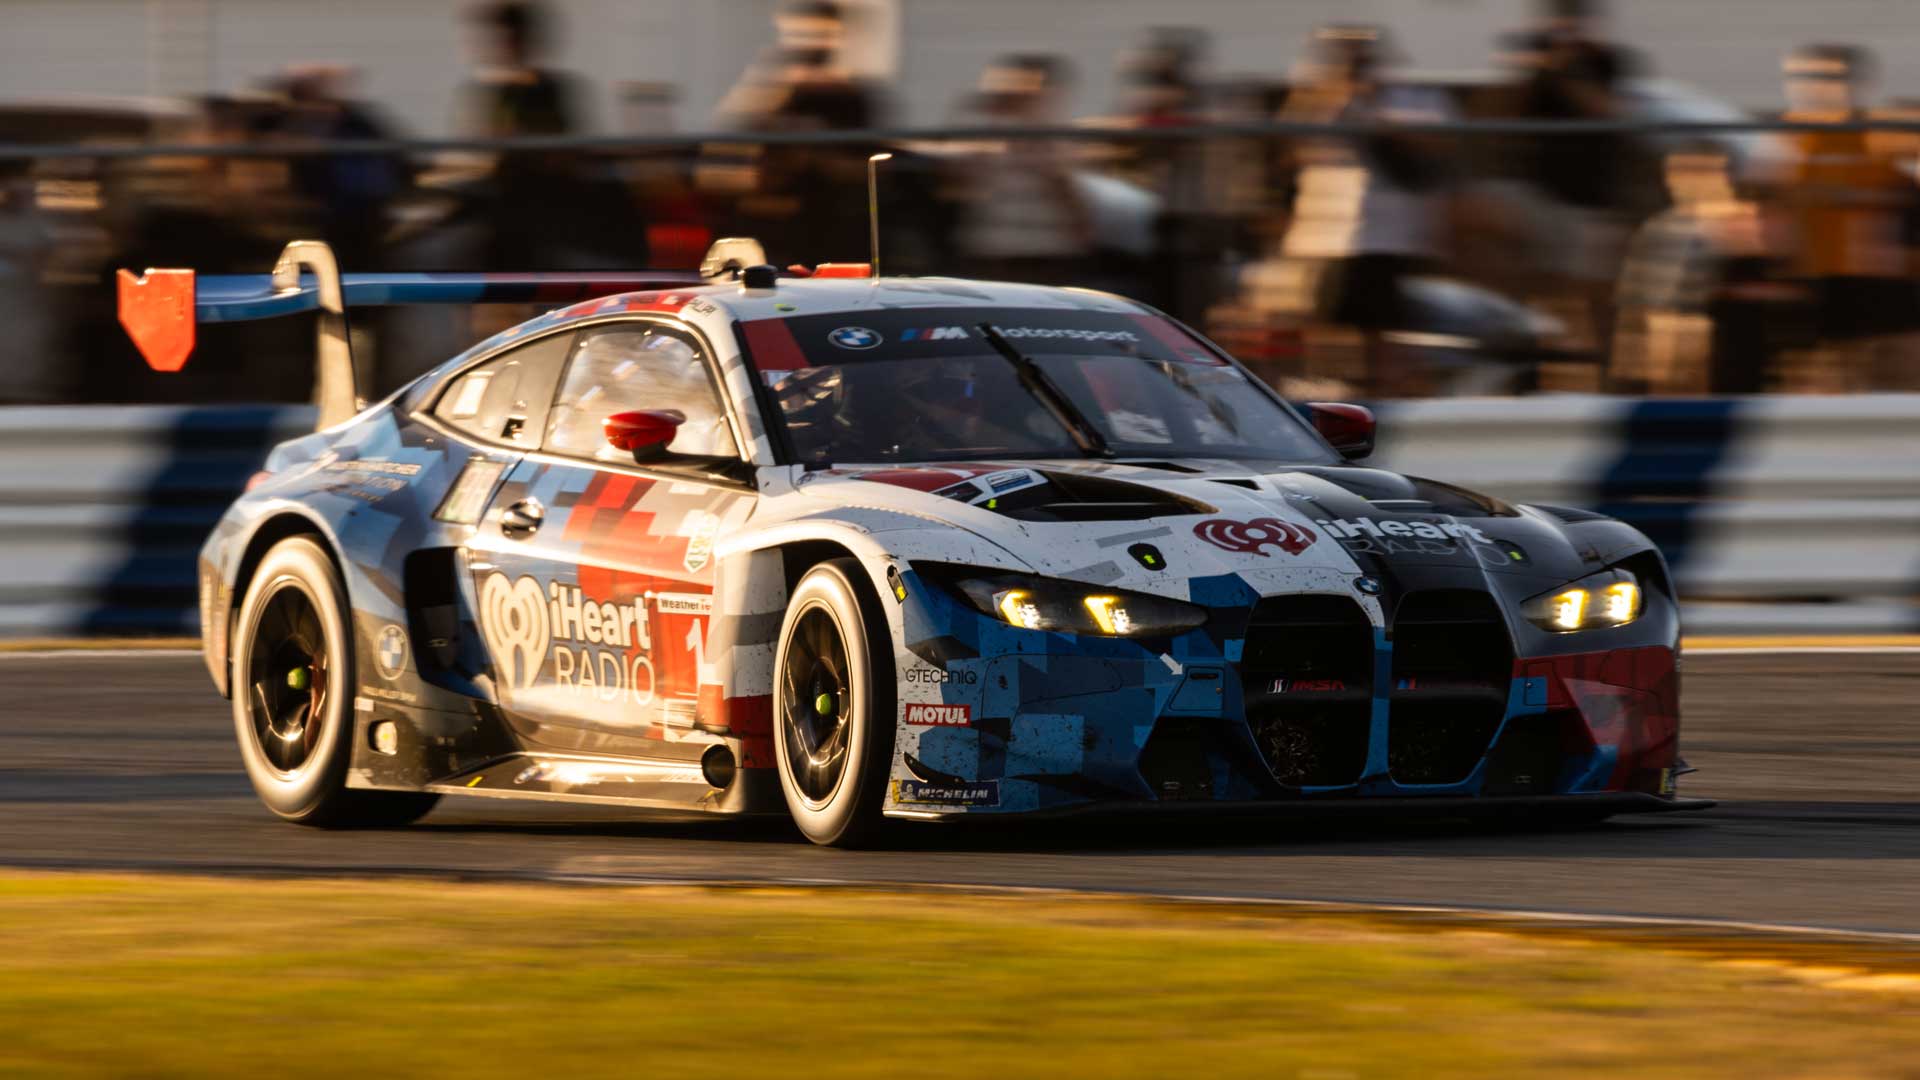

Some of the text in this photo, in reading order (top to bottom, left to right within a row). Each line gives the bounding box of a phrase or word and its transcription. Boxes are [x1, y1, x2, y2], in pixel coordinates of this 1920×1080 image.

[1317, 518, 1493, 544] iHeart
[1345, 540, 1511, 566] RADIO
[550, 580, 652, 649] iHeart
[660, 599, 711, 611] WeatherTe
[555, 646, 655, 706] RADIO
[906, 668, 977, 685] GTECHNIQ
[908, 706, 967, 723] MOTUL
[918, 788, 989, 799] MICHELIN
